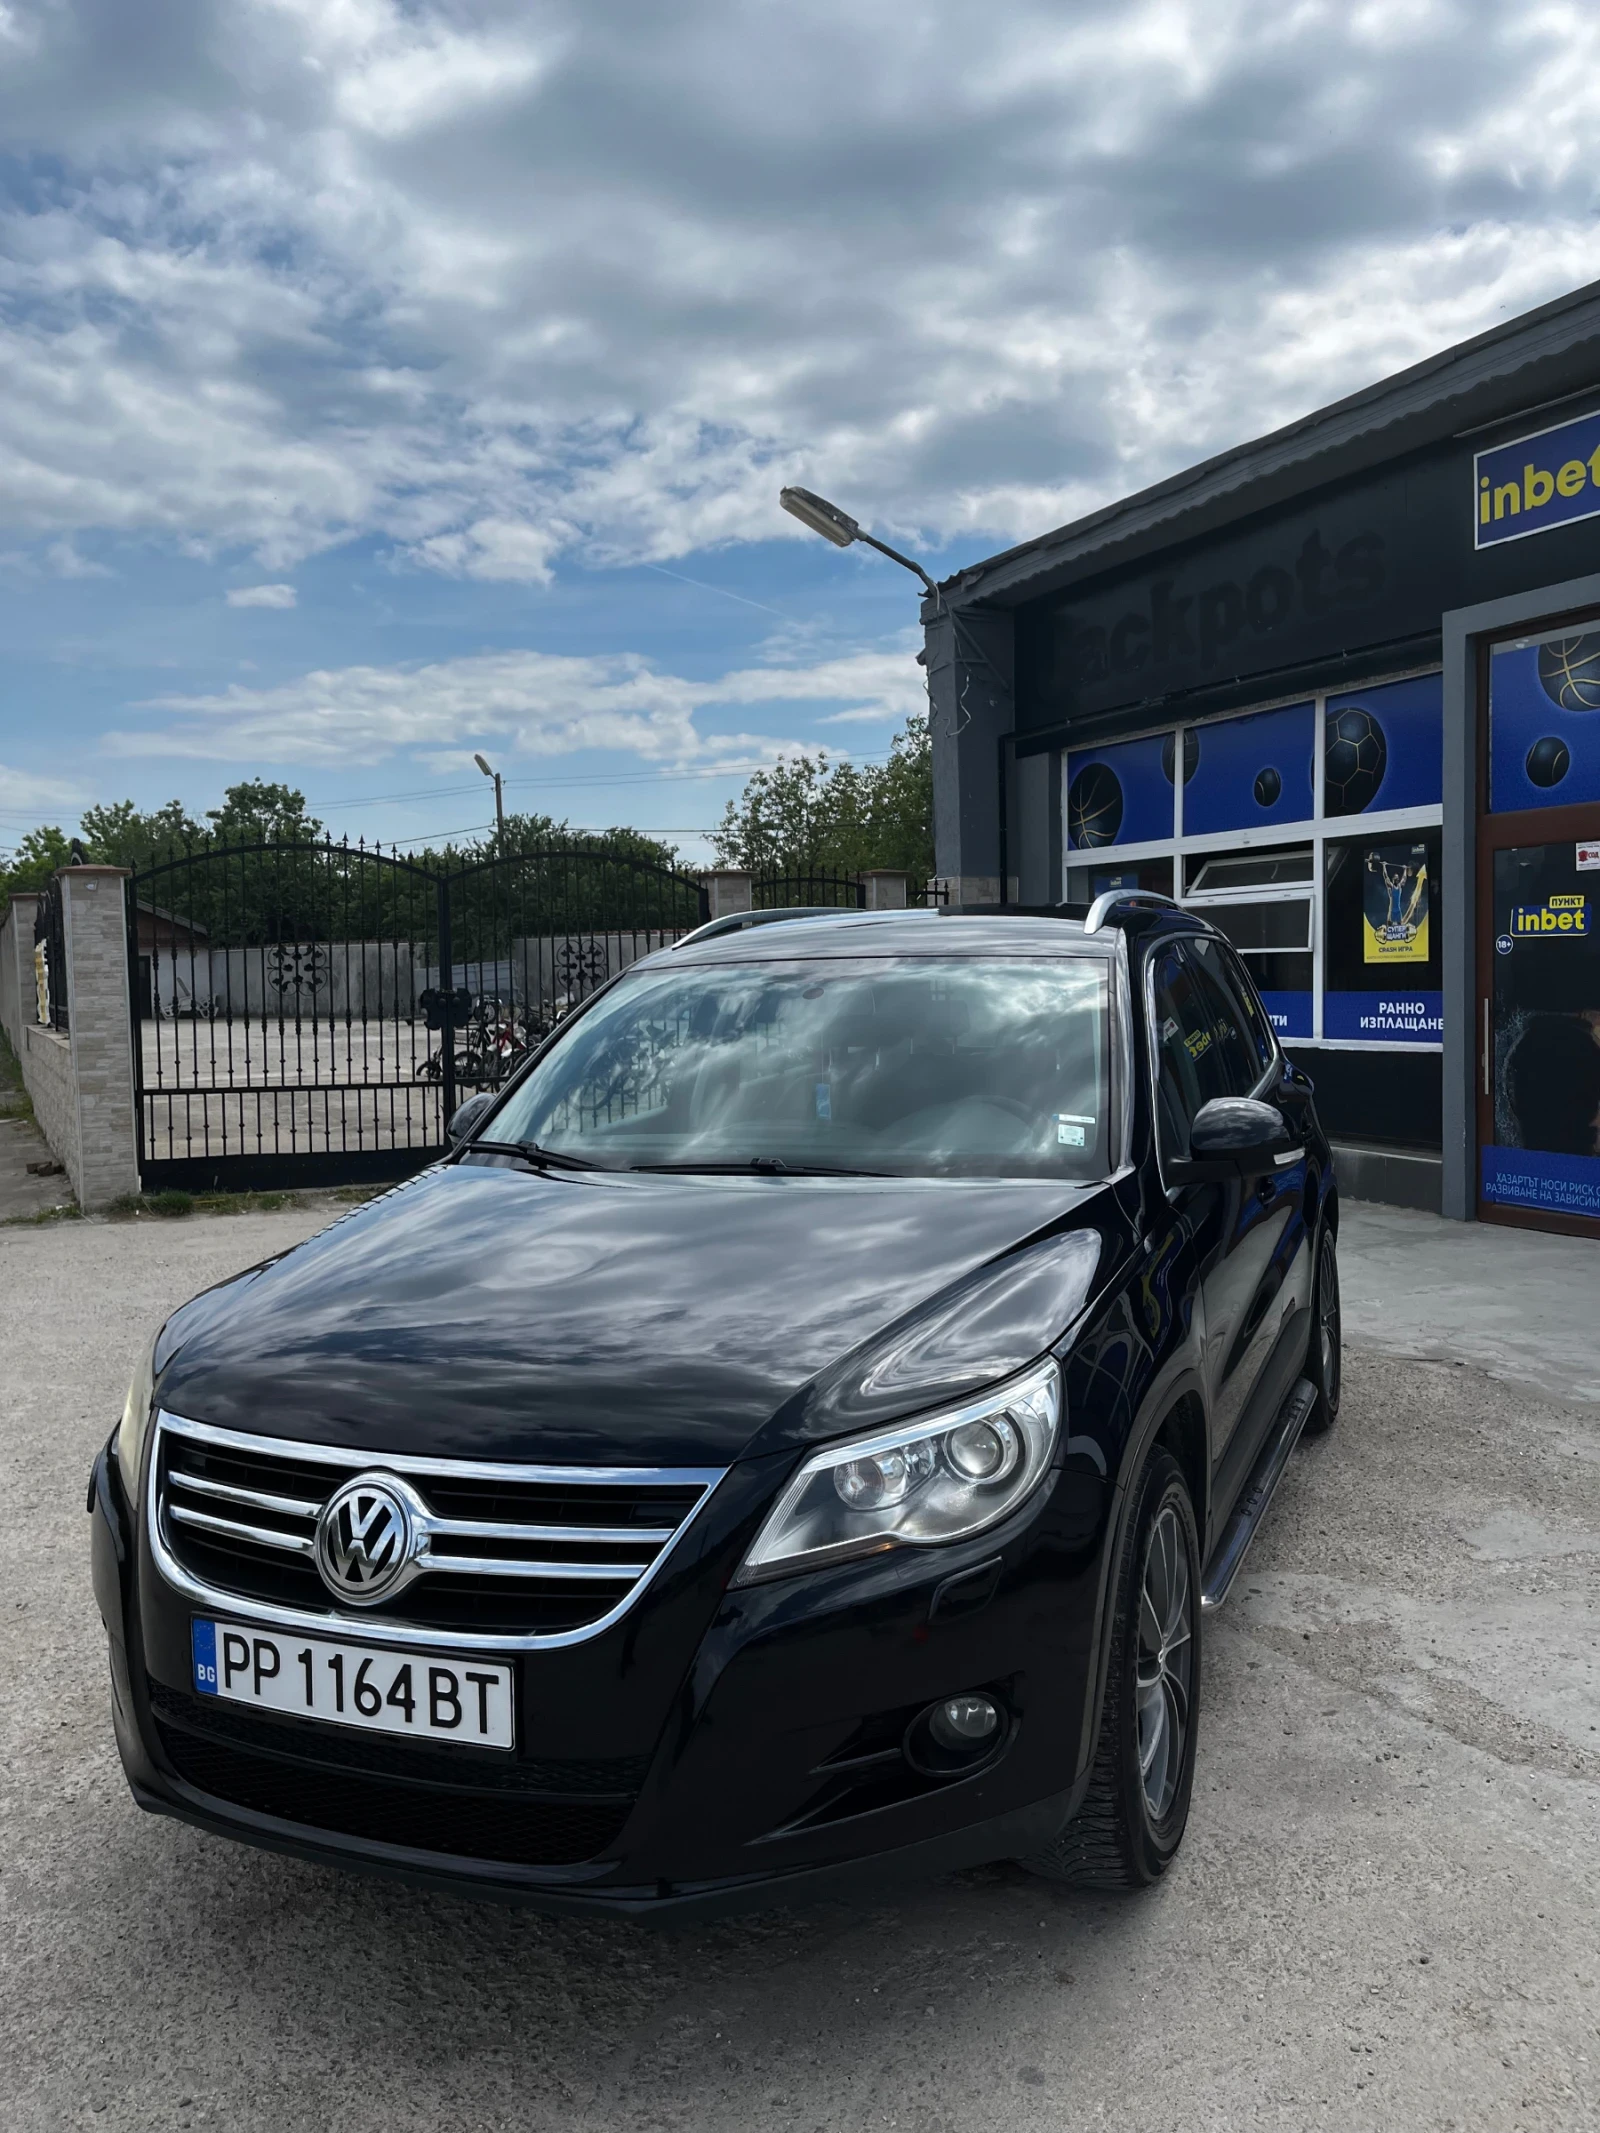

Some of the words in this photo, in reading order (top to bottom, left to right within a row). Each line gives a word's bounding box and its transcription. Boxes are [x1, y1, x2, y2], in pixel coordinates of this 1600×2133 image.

[1551, 897, 1582, 907] ПУНКТ
[1518, 907, 1585, 931] inbet
[1497, 940, 1511, 949] 18+
[1379, 1002, 1425, 1015] РАННО
[1360, 1017, 1444, 1031] ИЗПЛАЩАНЕ
[1485, 1182, 1538, 1199] РАЗВИВАНЕ
[1540, 1190, 1553, 1201] НА
[1496, 1172, 1538, 1188] ХАЗАРТЪТ
[1540, 1178, 1567, 1192] НОСИ
[1569, 1182, 1594, 1197] РИСК
[197, 1663, 216, 1684] BG
